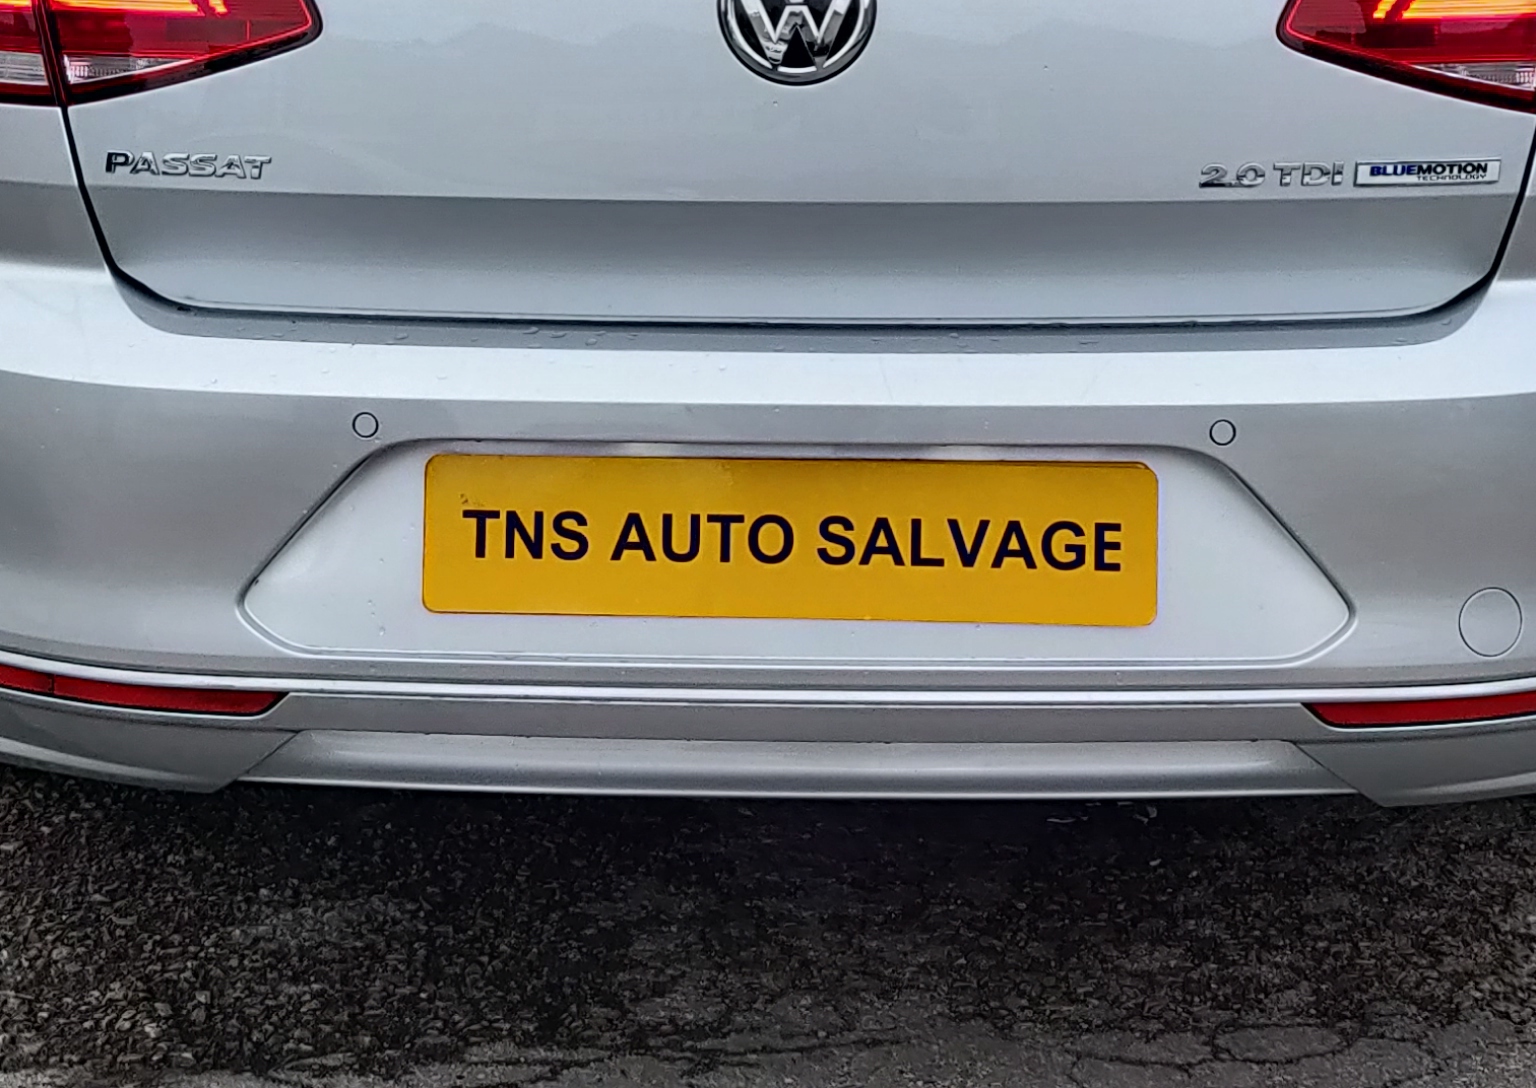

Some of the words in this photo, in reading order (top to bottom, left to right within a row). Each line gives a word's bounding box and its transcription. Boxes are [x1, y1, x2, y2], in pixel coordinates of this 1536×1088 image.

[105, 150, 272, 180] PASSAT
[1199, 162, 1265, 188] 2.0
[1272, 161, 1345, 187] TDI
[1369, 162, 1488, 177] BLUEMOTION
[462, 509, 589, 560] TNS
[609, 512, 794, 564] AUTO
[816, 515, 1122, 572] SALVAGE
